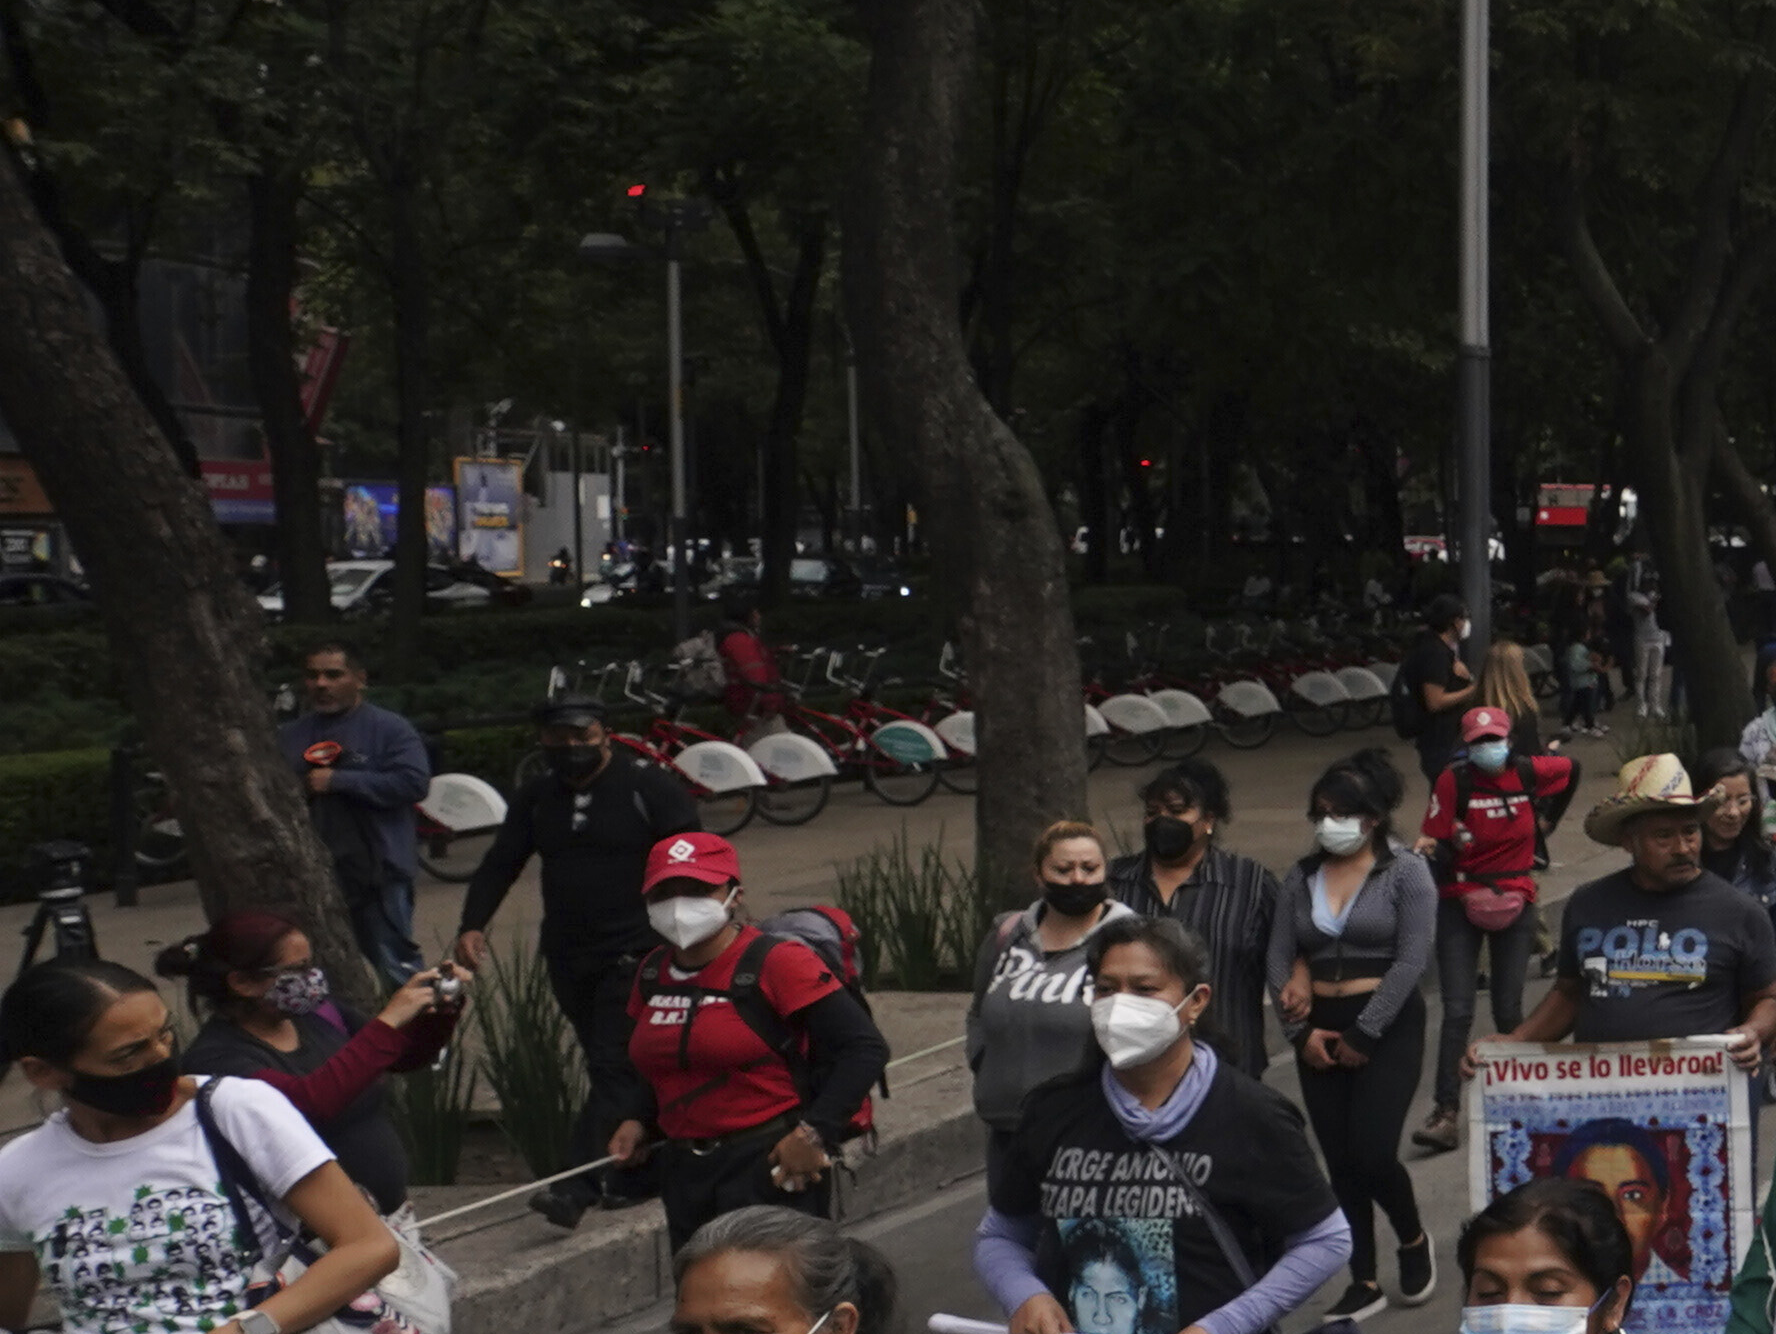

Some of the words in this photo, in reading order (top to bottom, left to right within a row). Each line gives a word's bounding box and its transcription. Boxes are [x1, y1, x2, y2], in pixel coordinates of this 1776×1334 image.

[1577, 926, 1709, 963] POLO
[1486, 1057, 1549, 1086] ¡Vivo
[1557, 1060, 1581, 1078] se
[1589, 1055, 1611, 1078] lo
[1619, 1052, 1723, 1077] llevaron!
